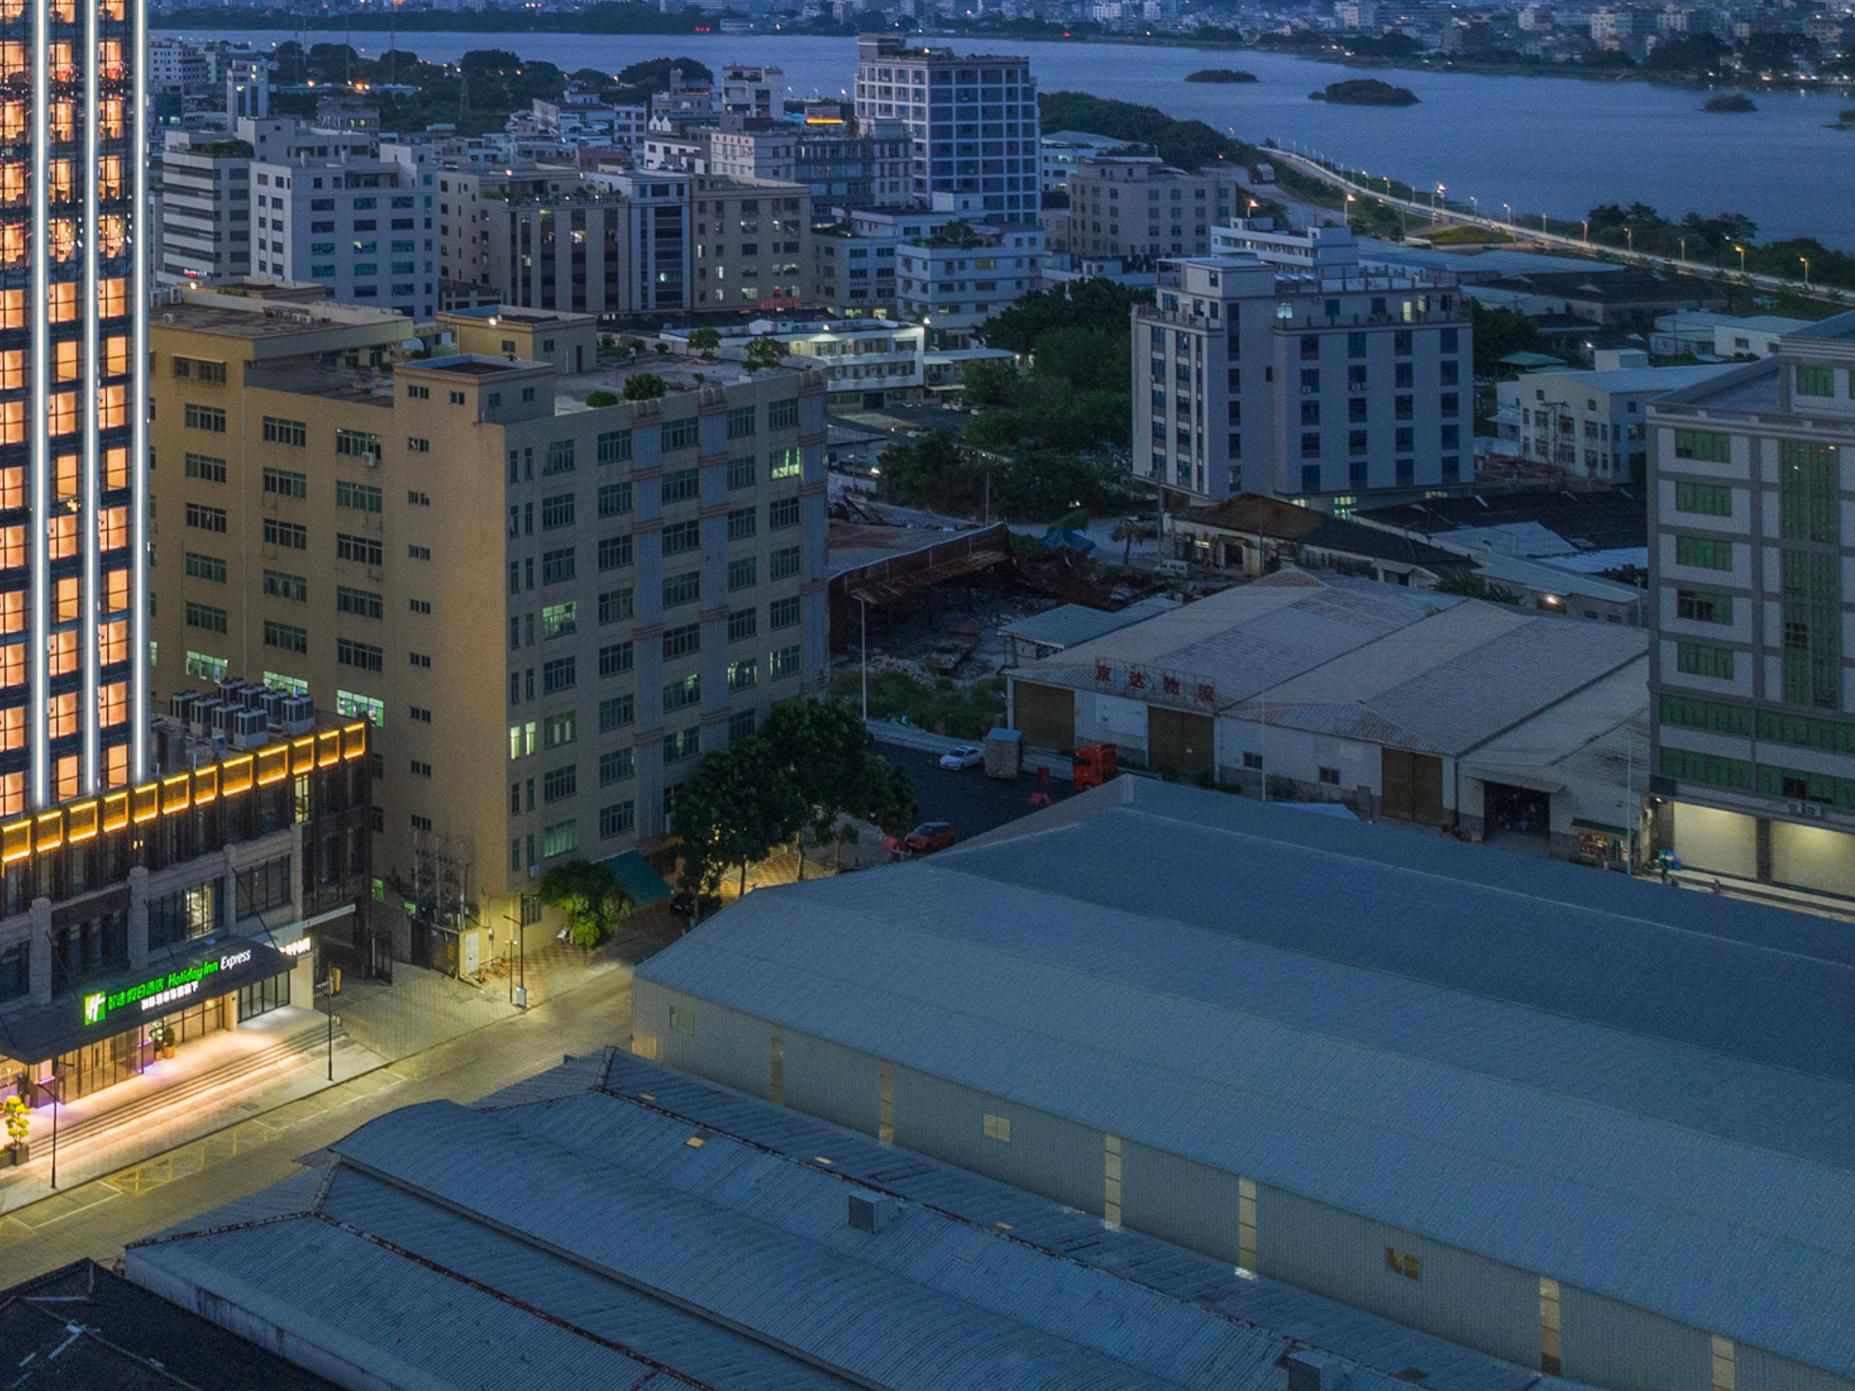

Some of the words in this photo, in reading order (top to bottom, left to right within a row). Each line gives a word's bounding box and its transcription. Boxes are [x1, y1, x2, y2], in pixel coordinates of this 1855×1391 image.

[167, 965, 203, 988] Holiday
[203, 962, 219, 977] Inn
[220, 949, 251, 971] Express
